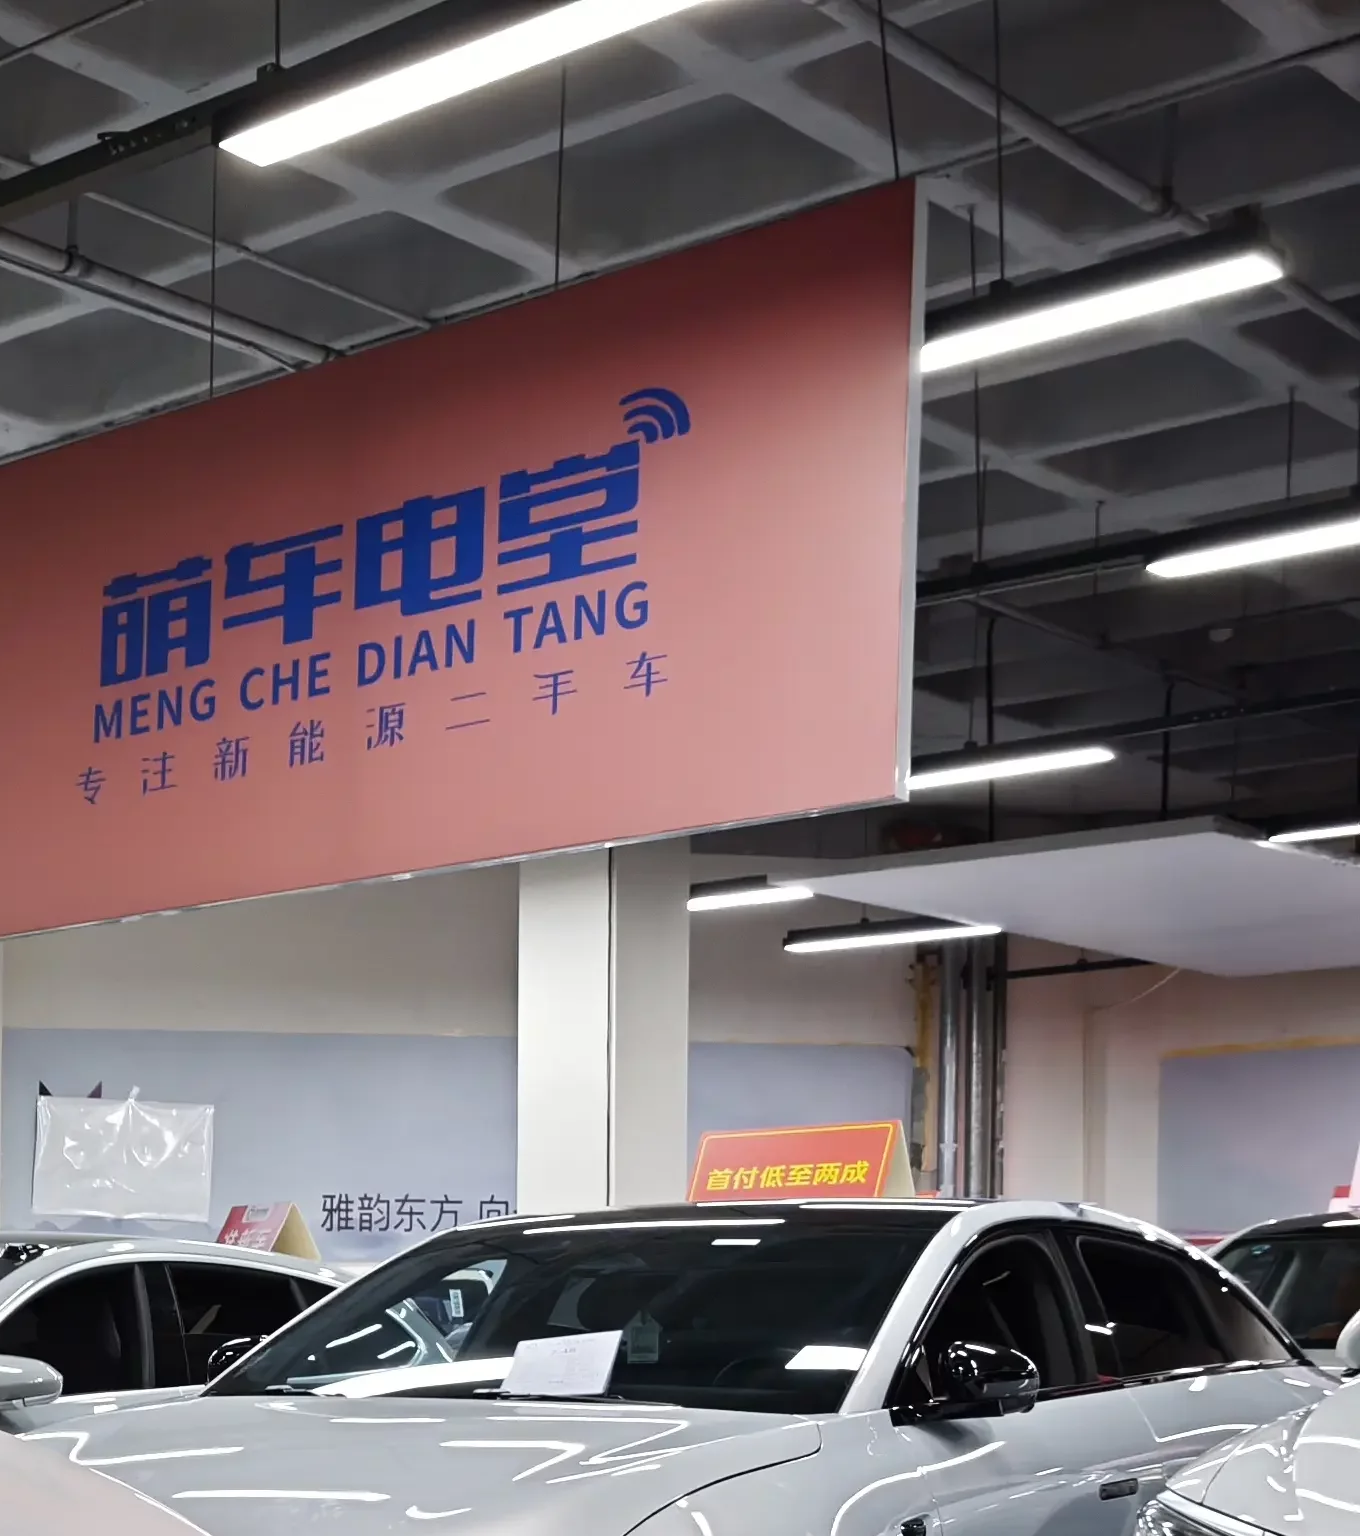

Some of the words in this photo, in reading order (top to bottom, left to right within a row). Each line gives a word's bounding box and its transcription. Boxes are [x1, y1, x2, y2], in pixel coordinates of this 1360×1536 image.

[98, 438, 641, 688] 萌车电堂
[75, 651, 669, 805] 专注新能源二手车
[91, 678, 218, 745] MENG
[238, 651, 332, 712] CHE
[356, 619, 477, 688] DIAN
[502, 580, 650, 653] TANG
[320, 1193, 463, 1232] 雅韵东方
[478, 1194, 517, 1221] 向
[706, 1159, 870, 1191] 首付低至两成
